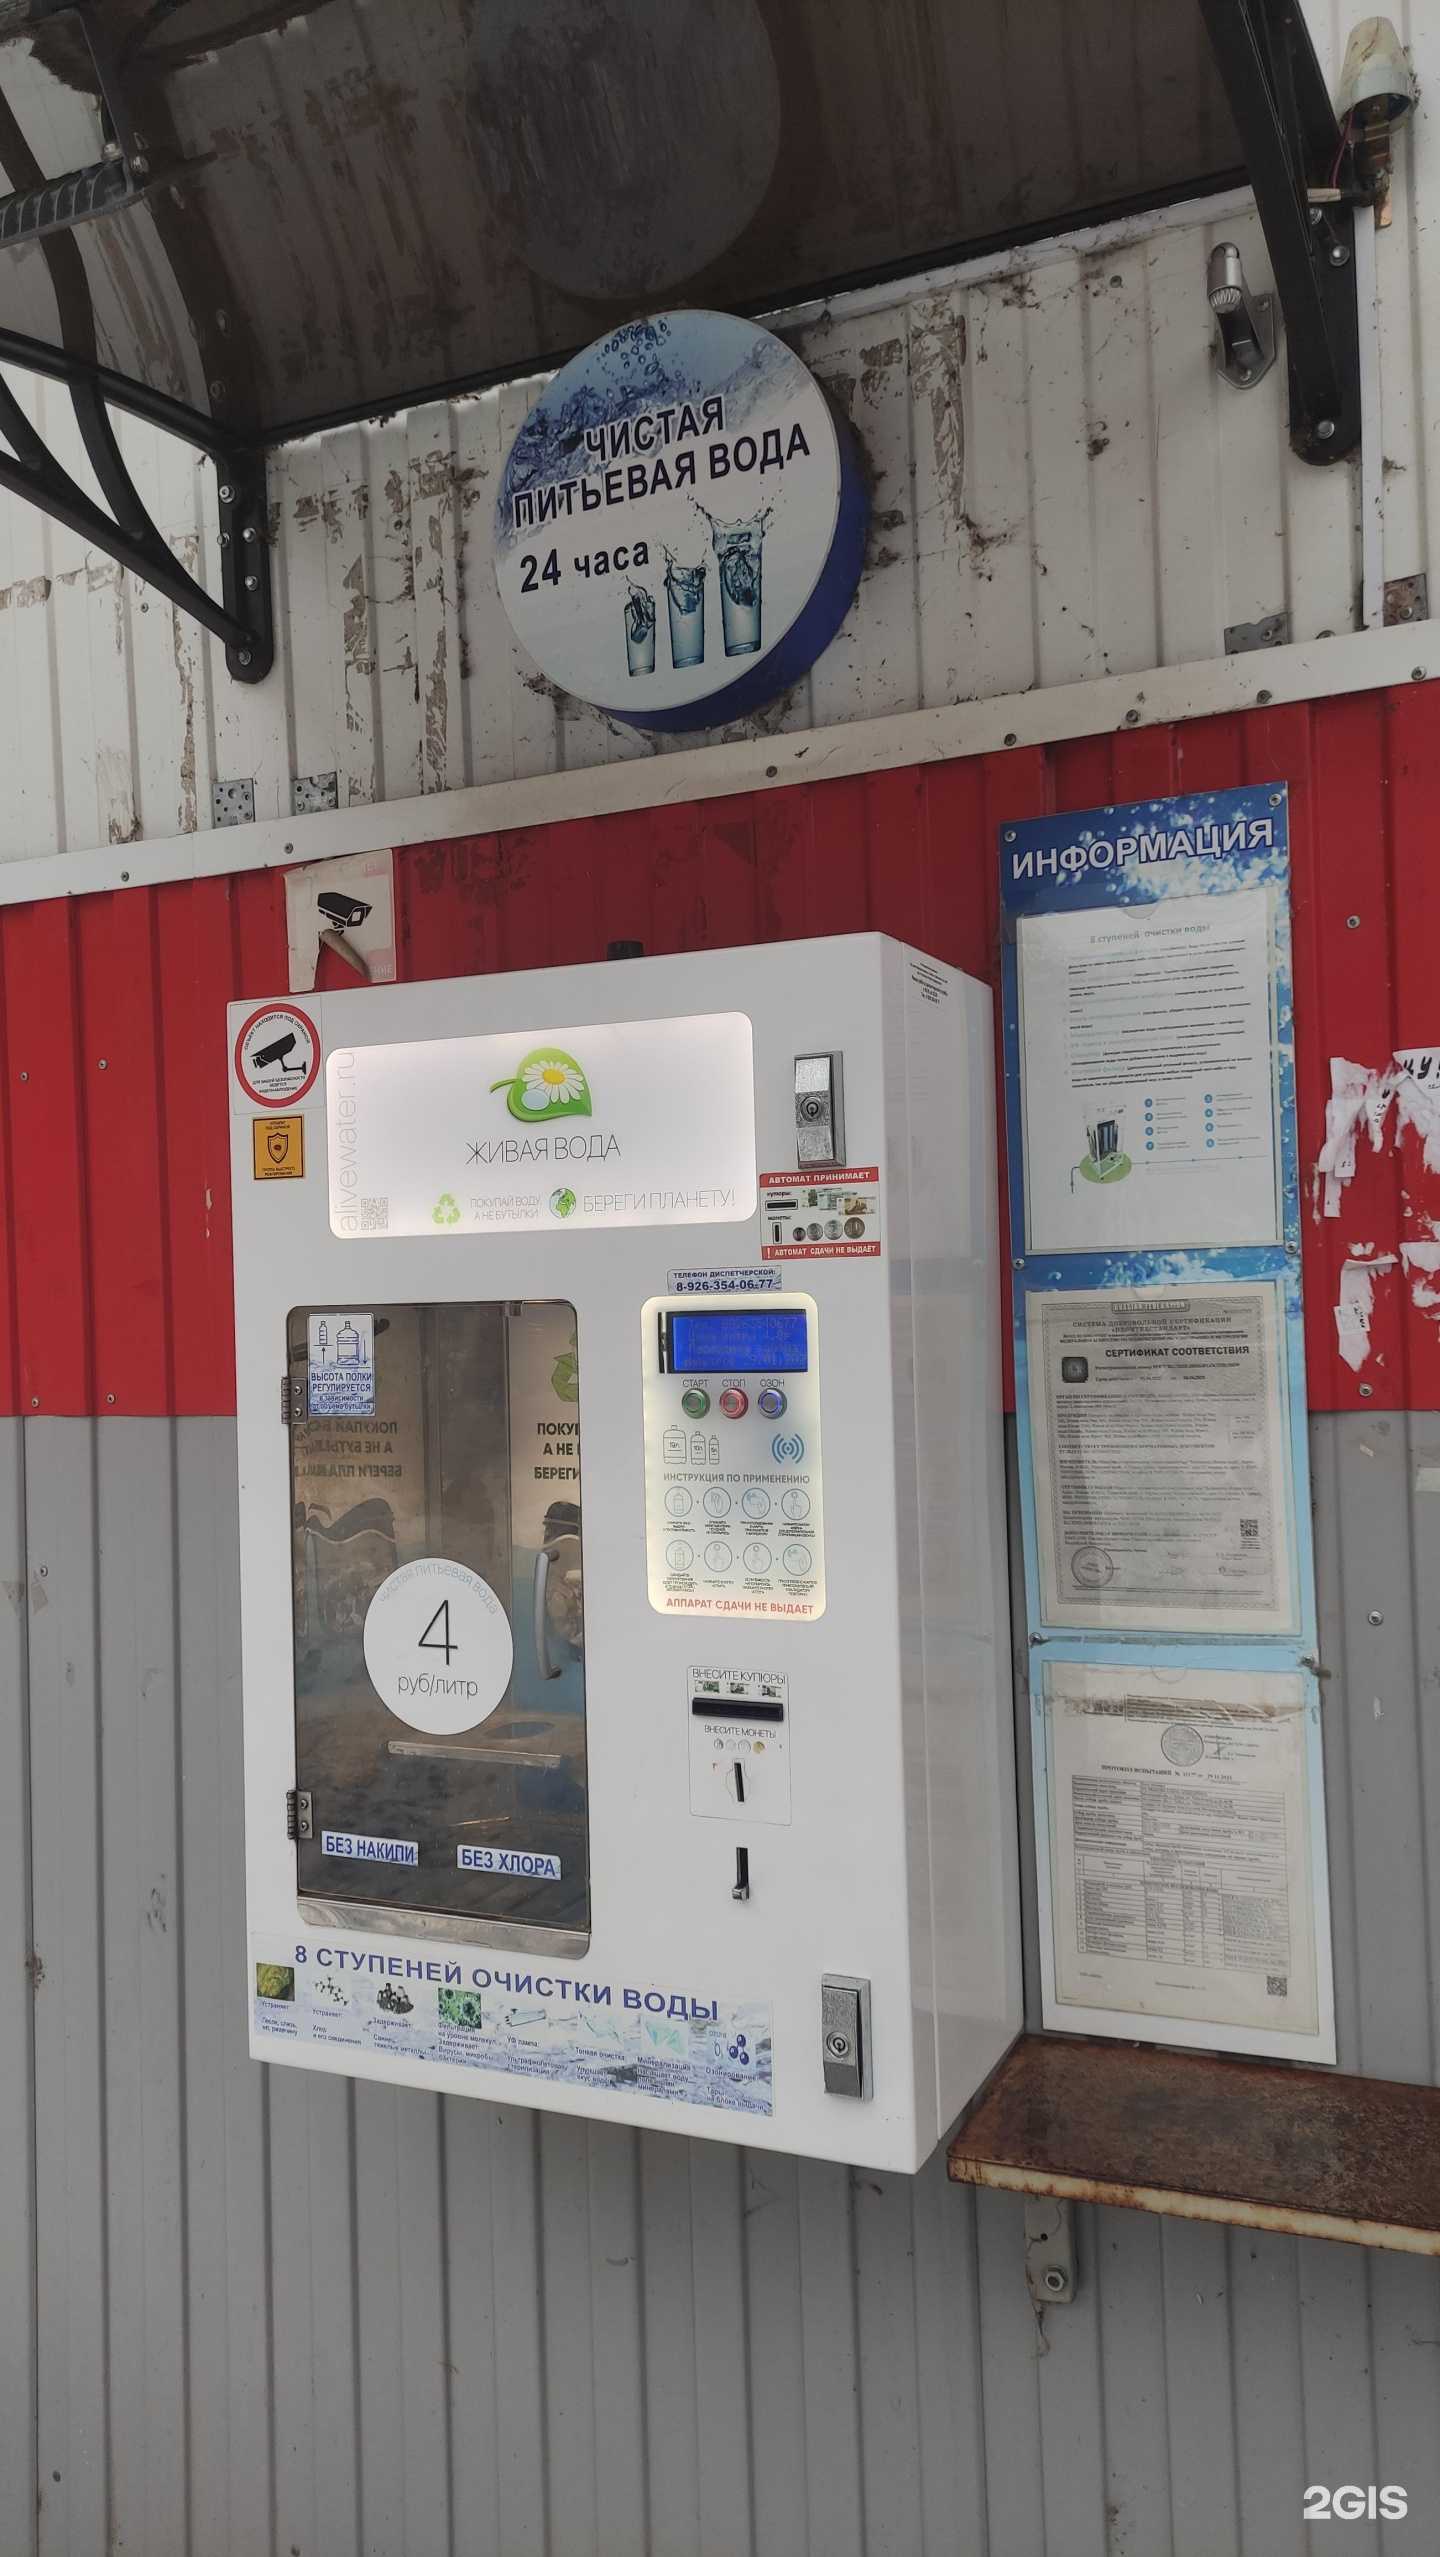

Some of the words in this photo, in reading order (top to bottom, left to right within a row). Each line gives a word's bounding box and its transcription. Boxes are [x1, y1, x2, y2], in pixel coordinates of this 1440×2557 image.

[585, 397, 725, 461] ЧИСТАЯ
[514, 451, 697, 528] ПИТЬЕВАЯ
[709, 423, 810, 480] ВОДА
[520, 549, 561, 593] 24
[574, 541, 649, 579] часа
[1012, 818, 1274, 880] ИНФОРМАЦИЯ
[466, 1137, 548, 1165] ЖИВАЯ
[554, 1133, 622, 1163] ВОДА
[769, 1175, 811, 1184] АВТОМАТ
[814, 1171, 870, 1181] ПРИНИМАЕТ
[583, 1191, 647, 1213] БЕРЕГИ
[650, 1188, 736, 1210] ПЛАНЕТУ!
[775, 1248, 807, 1256] АВТОМАТ
[810, 1247, 834, 1255] СДАЧИ
[846, 1245, 876, 1253] ВЫДАЕТ
[710, 1269, 776, 1277] ДИСПЕТЧЕРСКОЙ:
[676, 1279, 774, 1292] 8-926-354-06-77
[1105, 1348, 1169, 1358] СЕРТИФИКАТ
[1172, 1345, 1250, 1357] СООТВЕТСТВИЯ
[311, 1373, 344, 1381] ВЫСОТА
[346, 1372, 372, 1381] ПОЛКИ
[682, 1378, 709, 1388] СТАРТ
[722, 1378, 746, 1388] СТОП
[759, 1378, 785, 1387] ОЗОН
[313, 1383, 371, 1392] РЕГУЛИРУЕТСЯ
[543, 1442, 553, 1455] А
[556, 1442, 573, 1455] НЕ
[664, 1472, 725, 1483] ИНСТРУКЦИЯ
[726, 1473, 740, 1482] ПО
[743, 1474, 810, 1484] ПРИМЕНЕНИЮ
[666, 1598, 712, 1609] АППАРАТ
[716, 1599, 751, 1610] СДАЧИ
[754, 1601, 768, 1612] НЕ
[770, 1602, 814, 1614] ВЫДАЕТ
[418, 1599, 459, 1666] 4
[692, 1668, 739, 1681] ВНЕСИТЕ
[740, 1671, 786, 1685] КУПЮРЫ
[398, 1672, 479, 1698] руб/литр
[704, 1725, 741, 1736] ВНЕСИТЕ
[741, 1728, 776, 1739] МОНЕТЫ
[325, 1835, 354, 1856] БЕЗ
[357, 1839, 416, 1864] НАКИПИ
[461, 1848, 494, 1869] БЕЗ
[498, 1852, 556, 1877] ХЛОРА
[295, 1945, 307, 1963] 8
[316, 1947, 462, 1985] СТУПЕНЕЙ
[472, 1968, 611, 2006] ОЧИСТКИ
[623, 1988, 719, 2022] ВОДЫ
